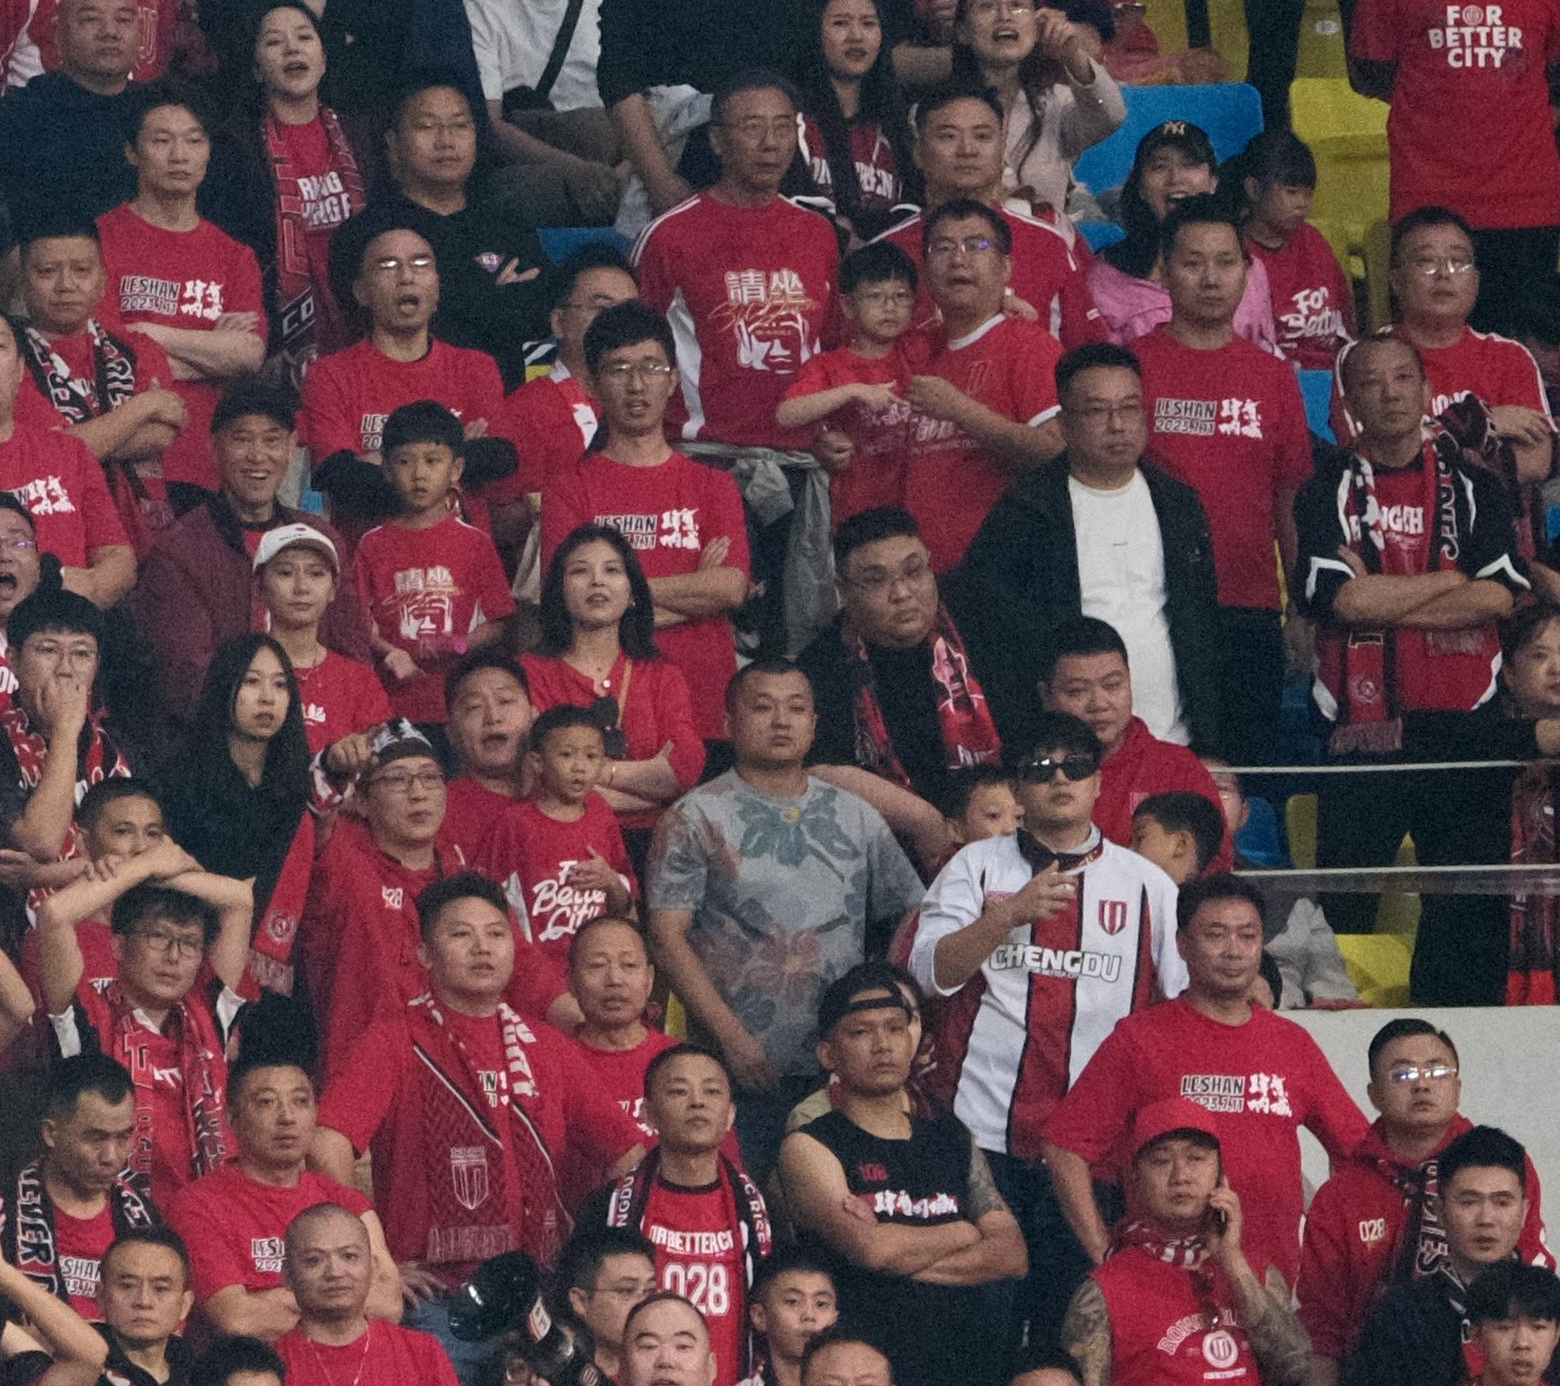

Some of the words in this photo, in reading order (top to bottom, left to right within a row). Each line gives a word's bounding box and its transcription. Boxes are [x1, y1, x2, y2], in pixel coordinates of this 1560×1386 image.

[1447, 6, 1502, 26] FOR
[1429, 27, 1522, 48] BETTER
[1447, 48, 1504, 69] CITY
[122, 275, 180, 297] LESHAN
[1154, 399, 1216, 419] LESHAN
[990, 943, 1120, 982] CHENGDU
[1182, 1074, 1244, 1095] LESHAN
